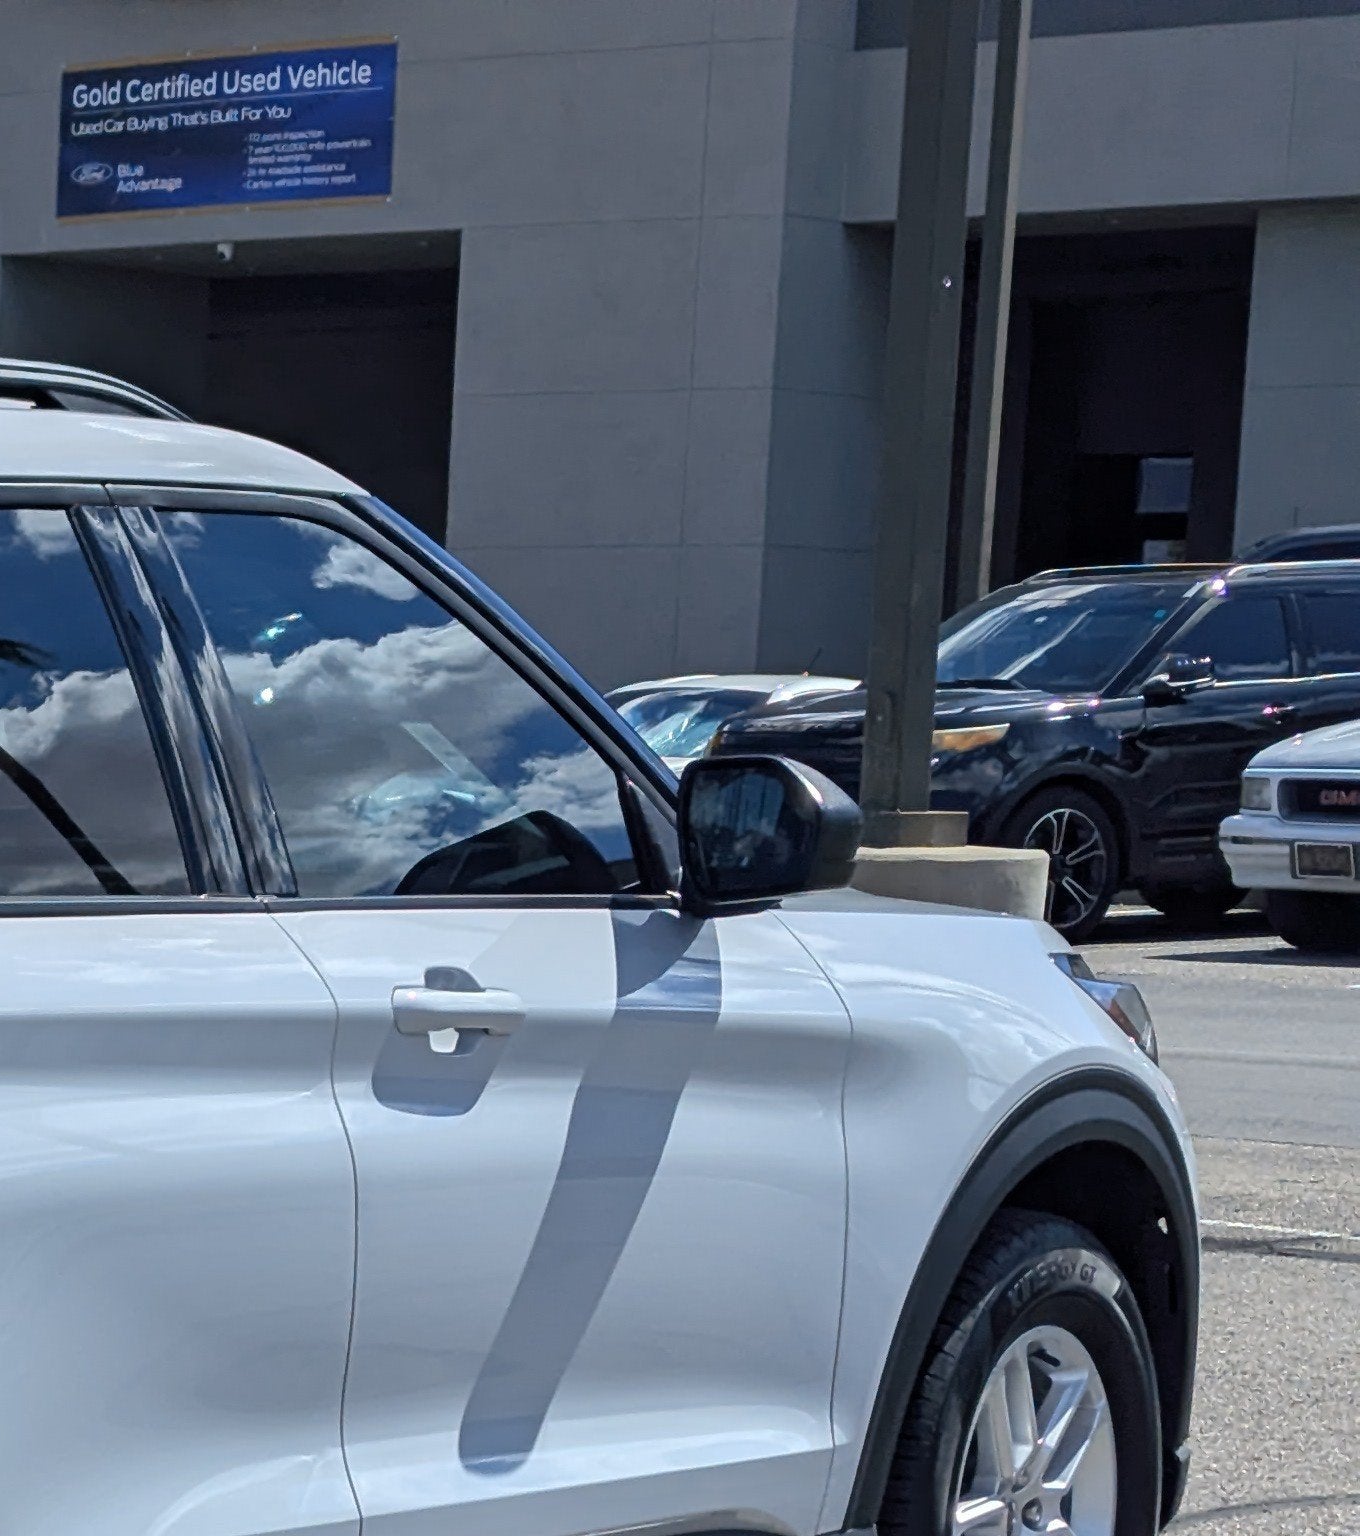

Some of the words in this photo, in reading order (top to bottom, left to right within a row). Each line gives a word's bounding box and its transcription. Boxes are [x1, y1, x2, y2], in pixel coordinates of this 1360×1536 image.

[72, 79, 122, 108] Gold
[125, 70, 217, 103] Certified
[223, 65, 281, 94] Used
[287, 59, 372, 90] Vehicle
[126, 115, 169, 132] Buying
[241, 106, 263, 121] For
[264, 104, 292, 119] You
[1319, 789, 1360, 805] GM
